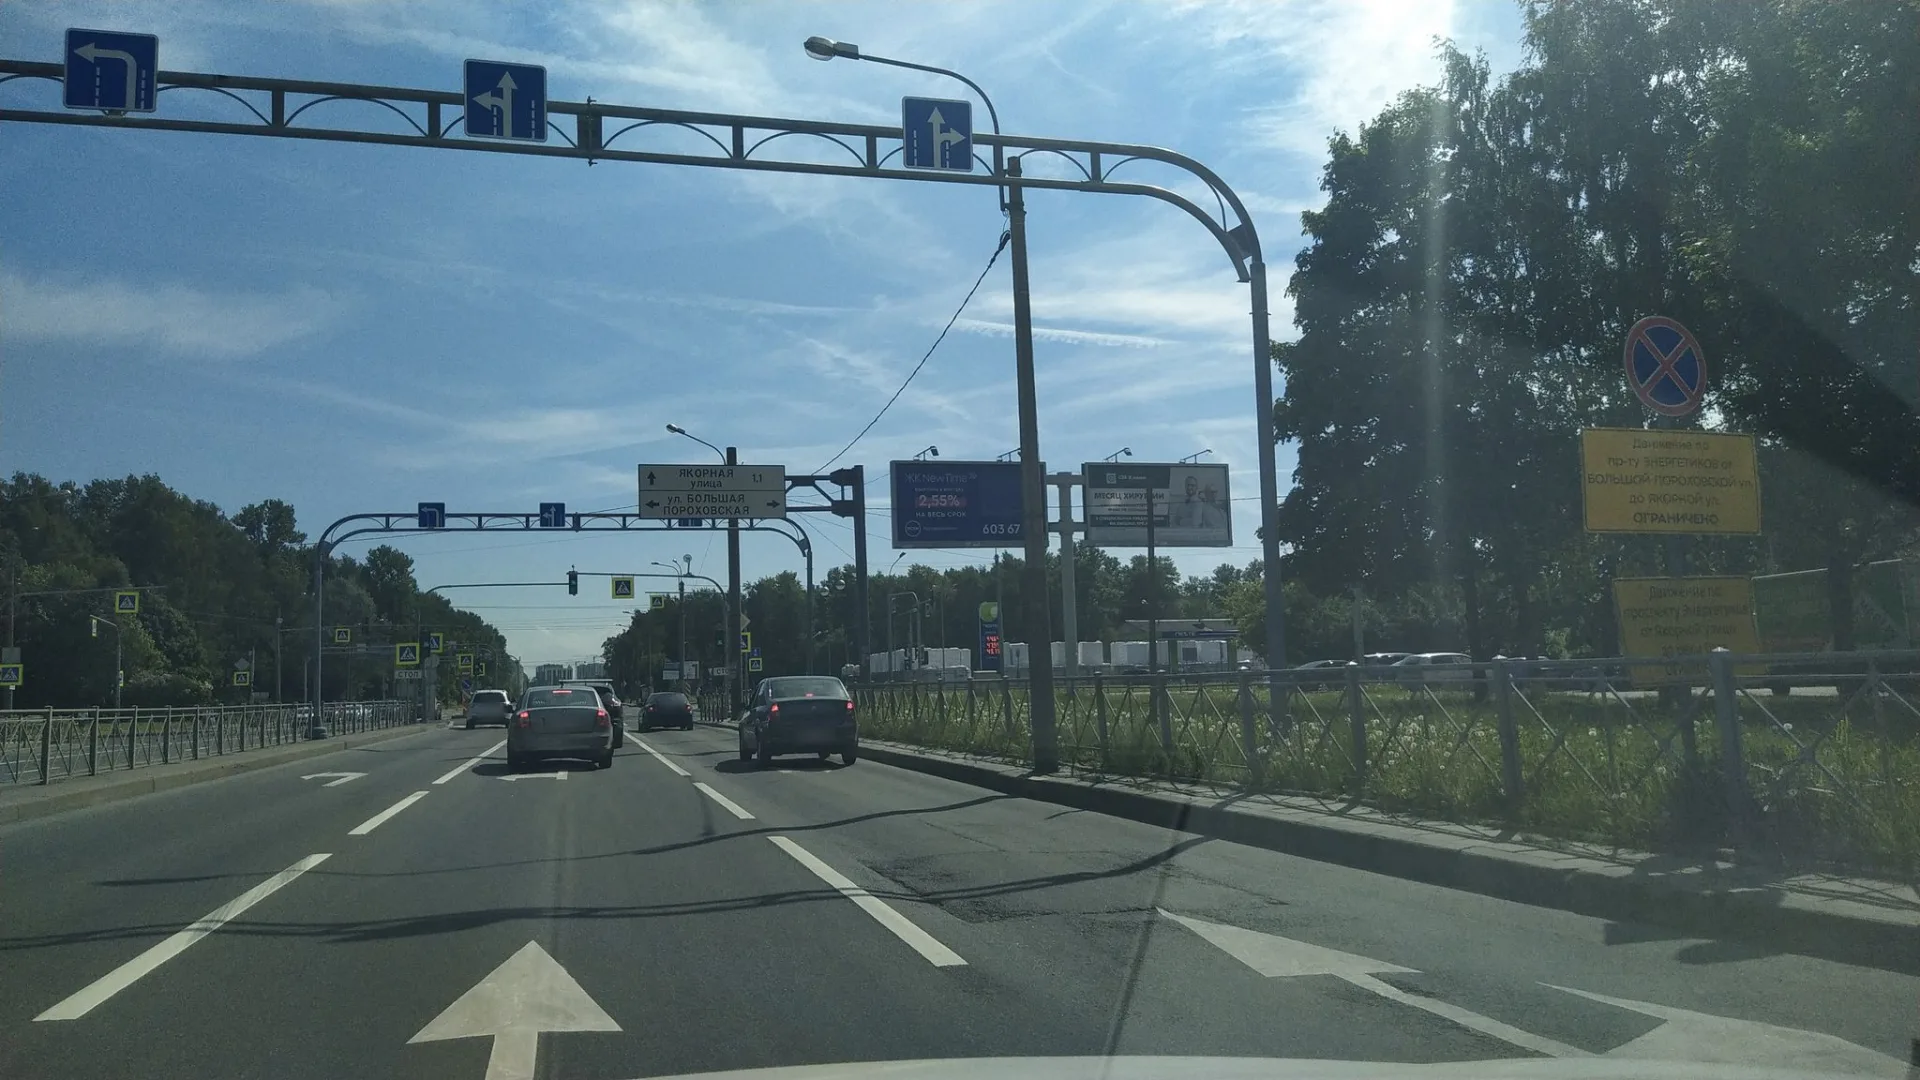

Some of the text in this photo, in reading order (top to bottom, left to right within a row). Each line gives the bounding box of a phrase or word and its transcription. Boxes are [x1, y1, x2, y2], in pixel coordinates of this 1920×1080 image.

[1643, 457, 1719, 469] ЭНЕРГЕТИКОВ
[679, 468, 734, 478] ЯКОРНАЯ
[690, 480, 723, 489] улица
[1587, 472, 1651, 485] БОЛЬШОЙ
[1654, 475, 1736, 487] ПОРОХОВСКОЙ
[667, 494, 745, 505] ул. БОЛЬШАЯ
[918, 495, 960, 508] 2,55%
[1649, 493, 1704, 505] ЯКОРНОЙ
[663, 506, 750, 515] ПОРОХОВСКАЯ
[1633, 512, 1719, 525] ОГРАНИЧЕНО
[982, 524, 1020, 534] 603 67
